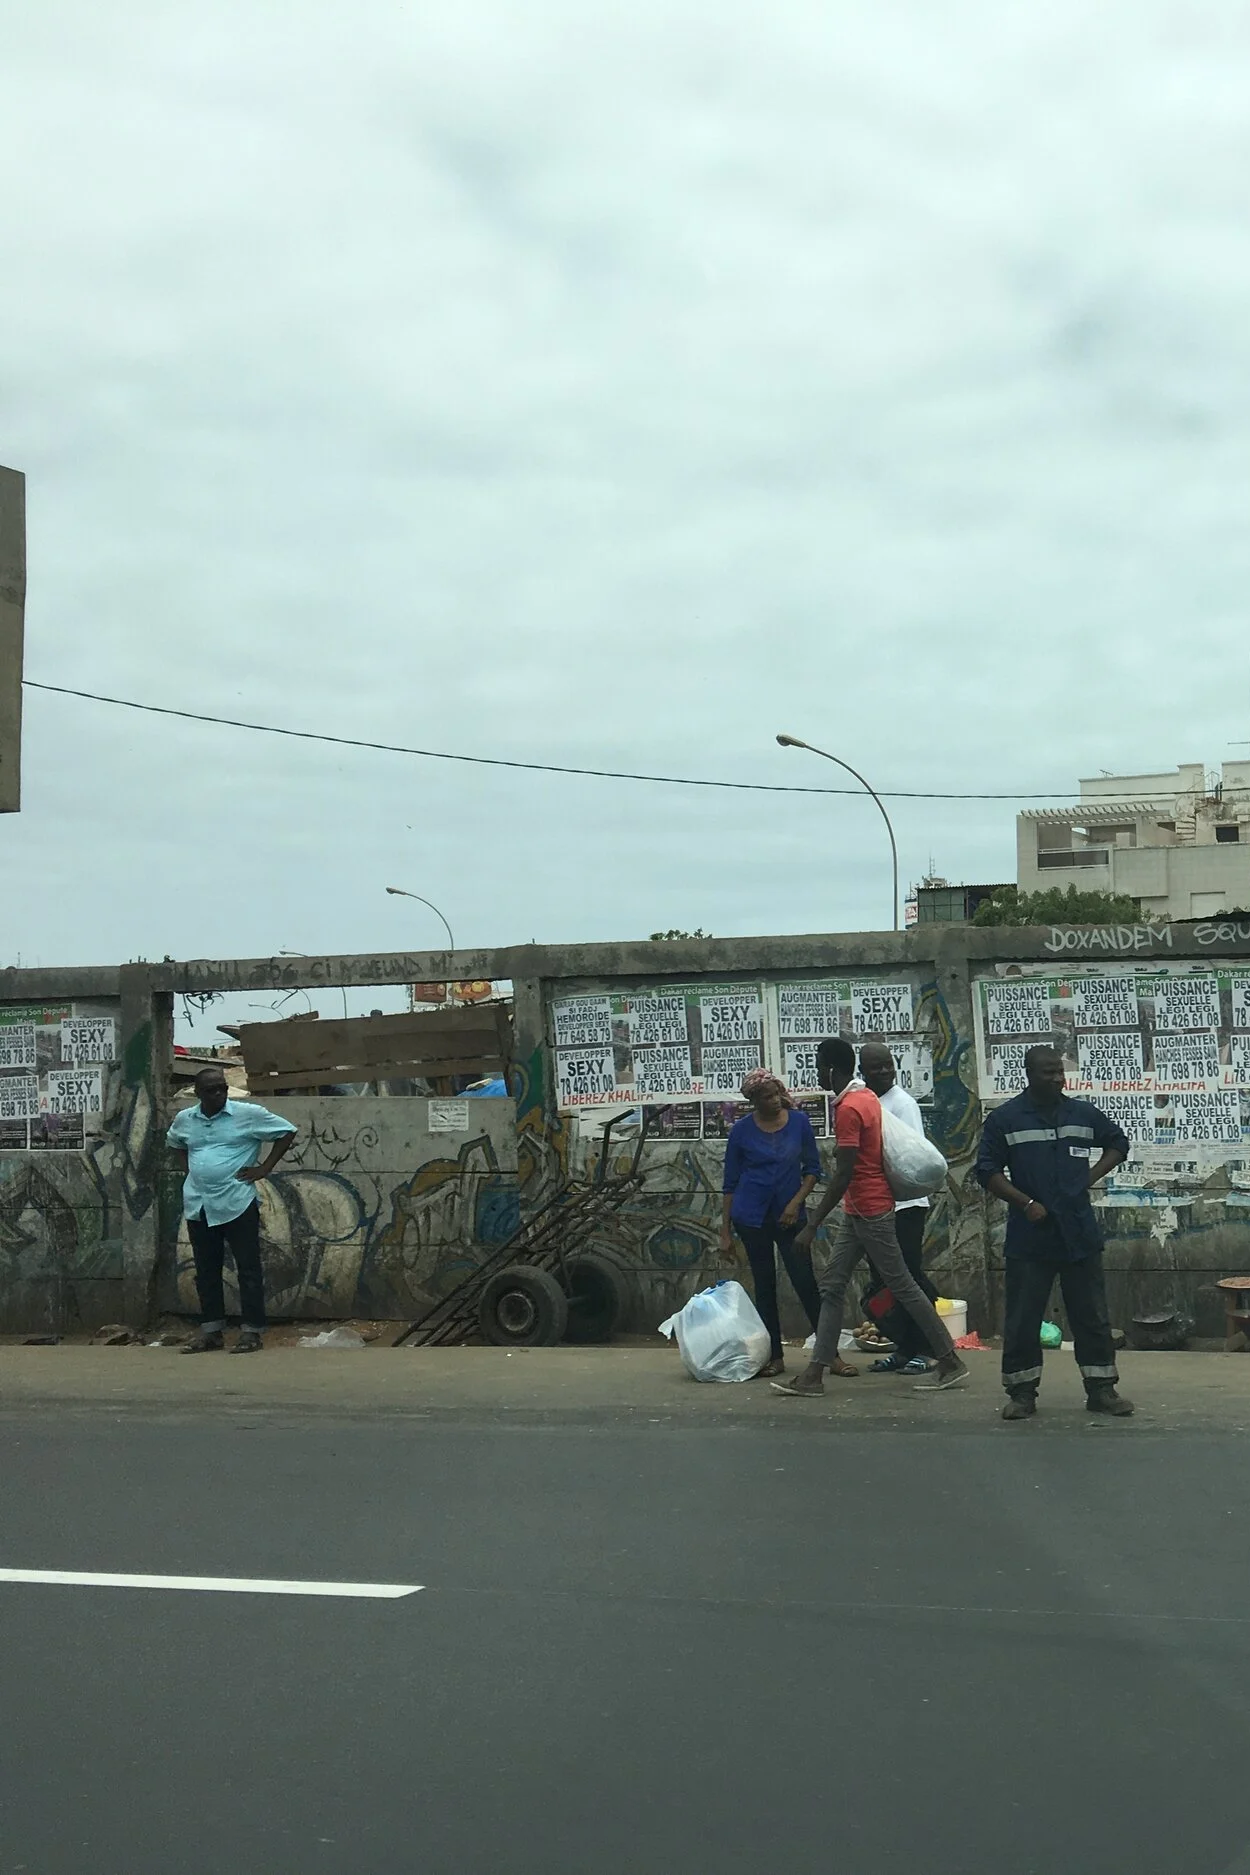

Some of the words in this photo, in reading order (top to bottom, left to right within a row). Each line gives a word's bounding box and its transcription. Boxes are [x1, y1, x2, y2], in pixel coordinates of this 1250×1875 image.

[1045, 926, 1173, 952] DOXANDEM
[1218, 970, 1242, 978] Dakar
[853, 987, 908, 997] DEVELOPPER
[1073, 979, 1134, 994] PUISSANCE
[1155, 981, 1216, 996] PUISSANCE
[702, 996, 756, 1006] DEVELOPPER
[781, 992, 836, 1002] AUGMANTER
[988, 987, 1048, 1001] PUISSANCE
[1085, 994, 1128, 1004] SEXUELLE
[1166, 996, 1211, 1006] SEXUELLE
[629, 998, 683, 1013] PUISSANCE
[862, 997, 901, 1013] SEXY
[1000, 1001, 1042, 1011] SEXUELLE
[557, 1012, 609, 1023] HEMOROIDE
[639, 1012, 679, 1022] SEXUELLE
[711, 1006, 749, 1022] SEXY
[1075, 1013, 1087, 1025] 78
[1090, 1012, 1107, 1024] 426
[1110, 1011, 1121, 1024] 61
[1125, 1011, 1136, 1023] 08
[1157, 1015, 1168, 1028] 78
[1172, 1014, 1189, 1027] 426
[1193, 1013, 1203, 1026] 61
[1207, 1013, 1219, 1026] 08
[1235, 1008, 1246, 1026] 78
[63, 1020, 112, 1028] DEVELOPPER
[558, 1022, 594, 1030] DEVELOPPER
[781, 1018, 791, 1033] 77
[795, 1018, 810, 1033] 698
[814, 1018, 823, 1033] 78
[827, 1018, 837, 1033] 86
[855, 1015, 865, 1032] 78
[868, 1014, 883, 1031] 426
[887, 1013, 896, 1030] 61
[900, 1013, 910, 1030] 08
[990, 1020, 1001, 1032] 78
[1004, 1019, 1021, 1032] 426
[1024, 1019, 1034, 1031] 61
[1039, 1018, 1050, 1031] 08
[70, 1029, 106, 1043] SEXY
[630, 1031, 641, 1042] 78
[644, 1029, 659, 1042] 426
[662, 1028, 671, 1041] 61
[675, 1028, 685, 1040] 08
[704, 1024, 714, 1041] 78
[717, 1023, 732, 1040] 426
[734, 1022, 744, 1039] 61
[747, 1021, 757, 1038] 08
[1079, 1035, 1140, 1049] PUISSANCE
[1155, 1035, 1215, 1048] AUGMANTER
[560, 1049, 610, 1061] DEVELOPPER
[634, 1048, 688, 1064] PUISSANCE
[703, 1047, 758, 1059] AUGMANTER
[1090, 1050, 1134, 1059] SEXUELLE
[567, 1059, 605, 1076] SEXY
[644, 1062, 683, 1072] SEXUELLE
[1080, 1068, 1092, 1080] 78
[1095, 1067, 1112, 1080] 426
[1115, 1067, 1126, 1079] 61
[1130, 1067, 1141, 1079] 08
[1157, 1064, 1168, 1080] 77
[1171, 1063, 1189, 1079] 698
[1192, 1061, 1204, 1078] 78
[1207, 1061, 1219, 1077] 86
[50, 1071, 99, 1080] DEVELOPPER
[704, 1074, 714, 1089] 77
[717, 1073, 733, 1089] 698
[901, 1070, 912, 1088] 08
[1234, 1070, 1245, 1082] 78
[58, 1081, 93, 1096] SEXY
[636, 1081, 646, 1093] 78
[649, 1079, 664, 1092] 426
[667, 1078, 677, 1091] 61
[680, 1078, 691, 1090] 08
[994, 1078, 1005, 1090] 78
[1009, 1077, 1025, 1090] 426
[563, 1093, 605, 1106] LIBEREZ
[1175, 1093, 1237, 1108] PUISSANCE
[1186, 1108, 1231, 1118] SEXUELLE
[1127, 1128, 1138, 1141] 61
[1142, 1128, 1153, 1141] 08
[1177, 1127, 1188, 1140] 78
[1192, 1126, 1209, 1139] 426
[1212, 1125, 1223, 1138] 61
[1228, 1125, 1239, 1138] 08
